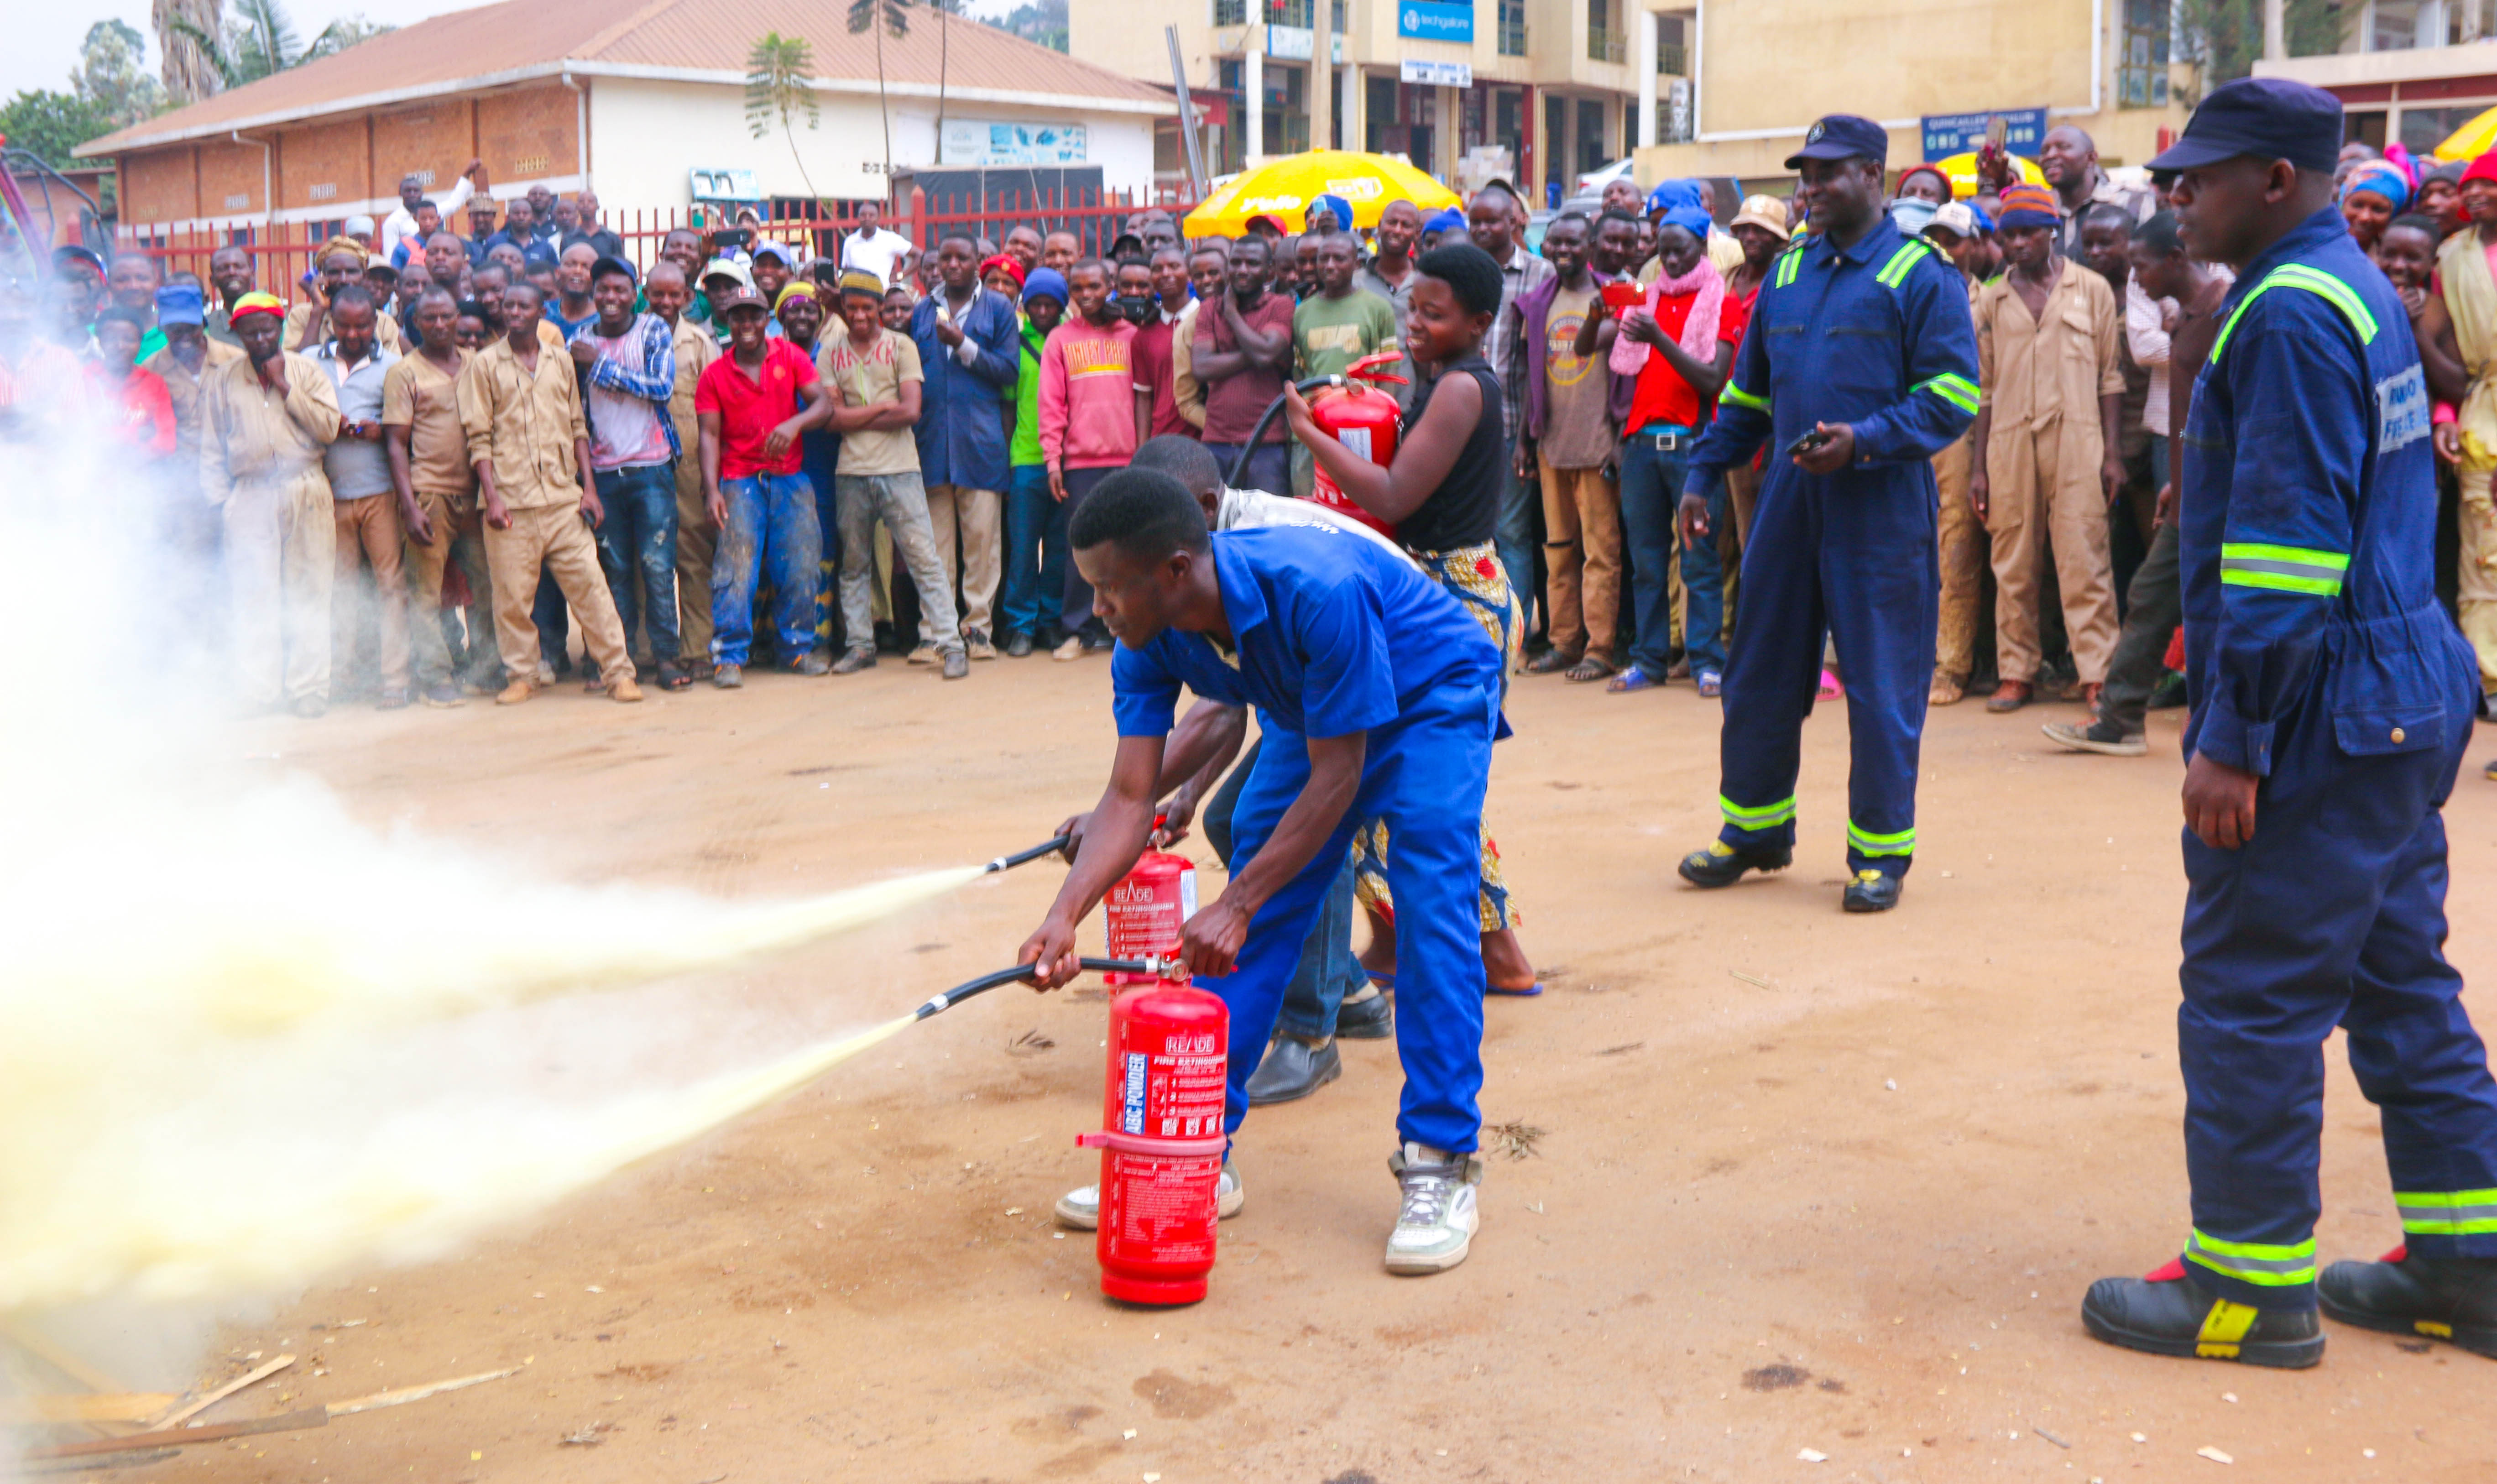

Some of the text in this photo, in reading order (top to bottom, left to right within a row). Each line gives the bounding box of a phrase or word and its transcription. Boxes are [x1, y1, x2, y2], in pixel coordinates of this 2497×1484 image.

[1154, 1055, 1176, 1066] FIRE
[1171, 1077, 1177, 1087] 1
[1125, 1054, 1145, 1134] ABC POWDER
[1170, 1092, 1177, 1102] 2
[1169, 1106, 1176, 1116] 3
